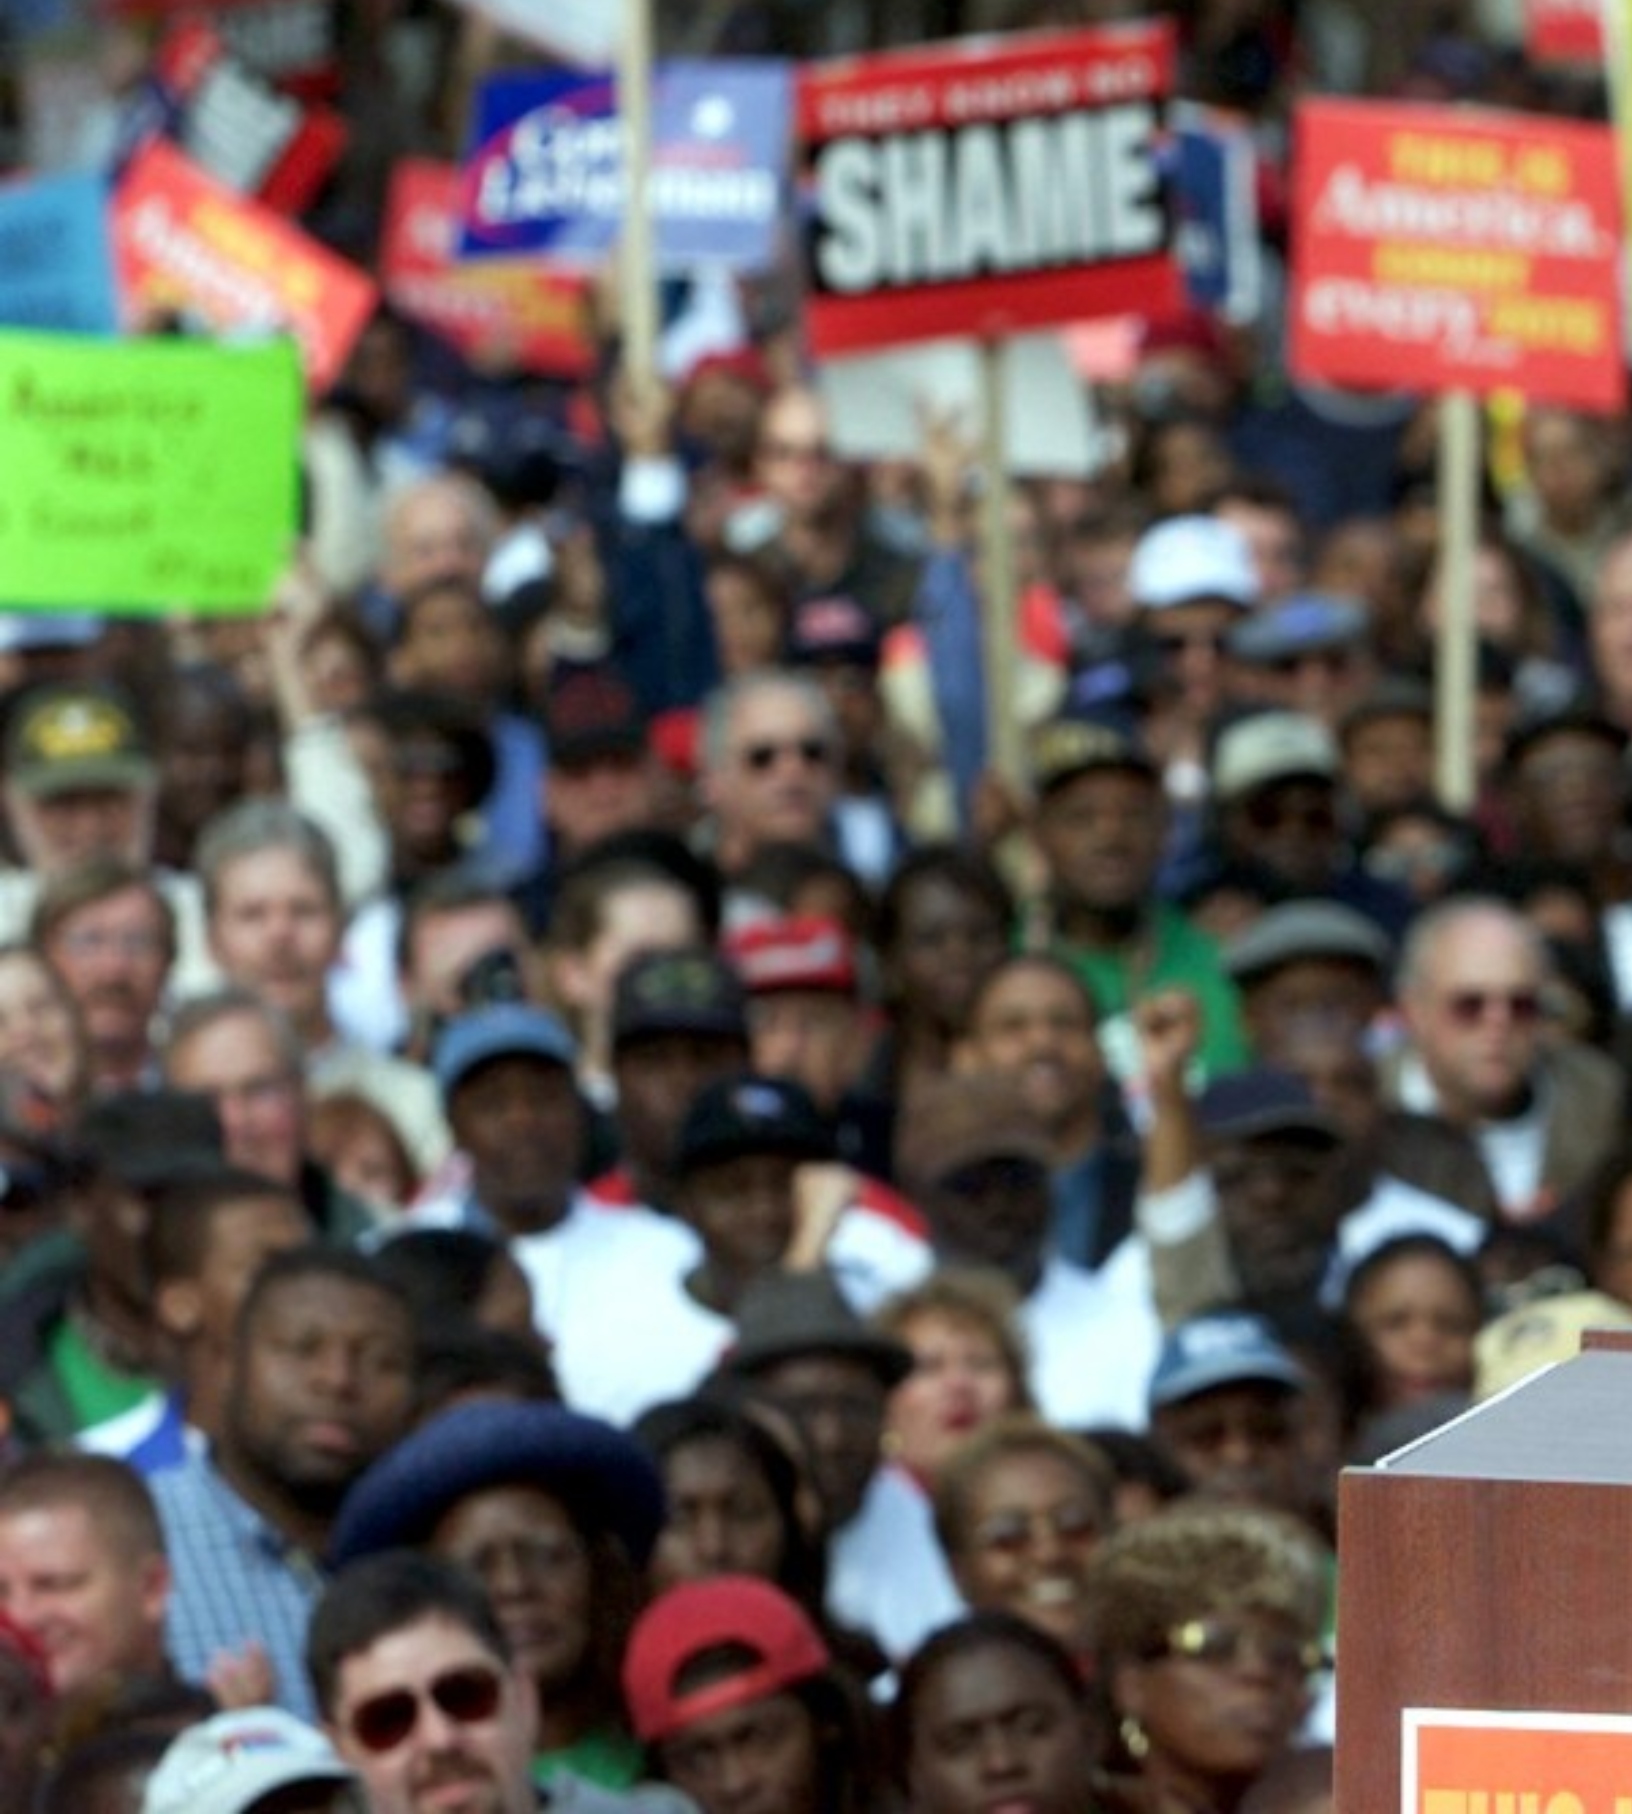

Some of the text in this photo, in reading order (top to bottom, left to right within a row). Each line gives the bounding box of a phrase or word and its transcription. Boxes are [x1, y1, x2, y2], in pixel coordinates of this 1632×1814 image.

[821, 52, 1156, 130] THEY KNOW NO
[822, 102, 1163, 295] SHAME
[1392, 129, 1574, 199] THIS IS
[1308, 161, 1618, 260] America.
[1303, 274, 1608, 358] every VOTE
